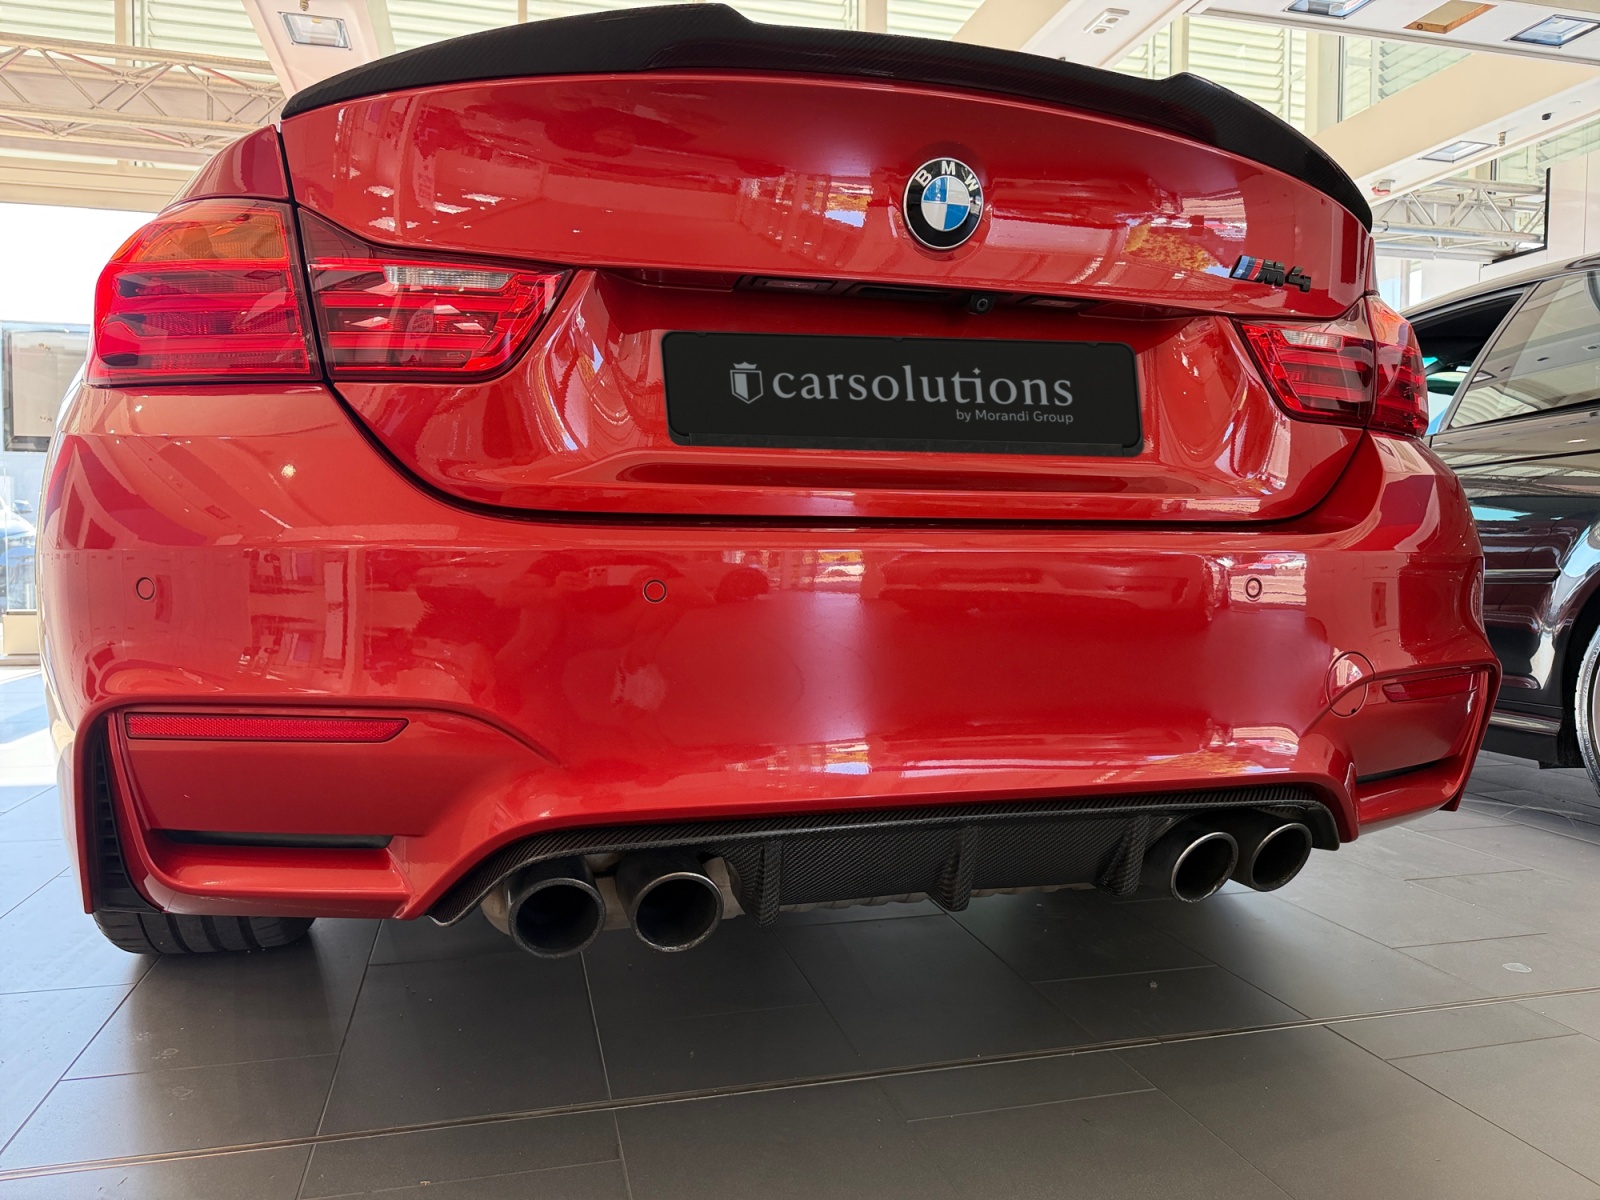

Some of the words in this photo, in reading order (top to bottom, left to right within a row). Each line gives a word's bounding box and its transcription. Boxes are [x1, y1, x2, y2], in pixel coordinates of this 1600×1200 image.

[914, 160, 979, 192] BMW
[1251, 258, 1312, 293] M4
[772, 364, 1073, 406] carsolutions
[956, 409, 971, 423] by
[975, 409, 1029, 422] Morandi
[1033, 411, 1074, 425] Group
